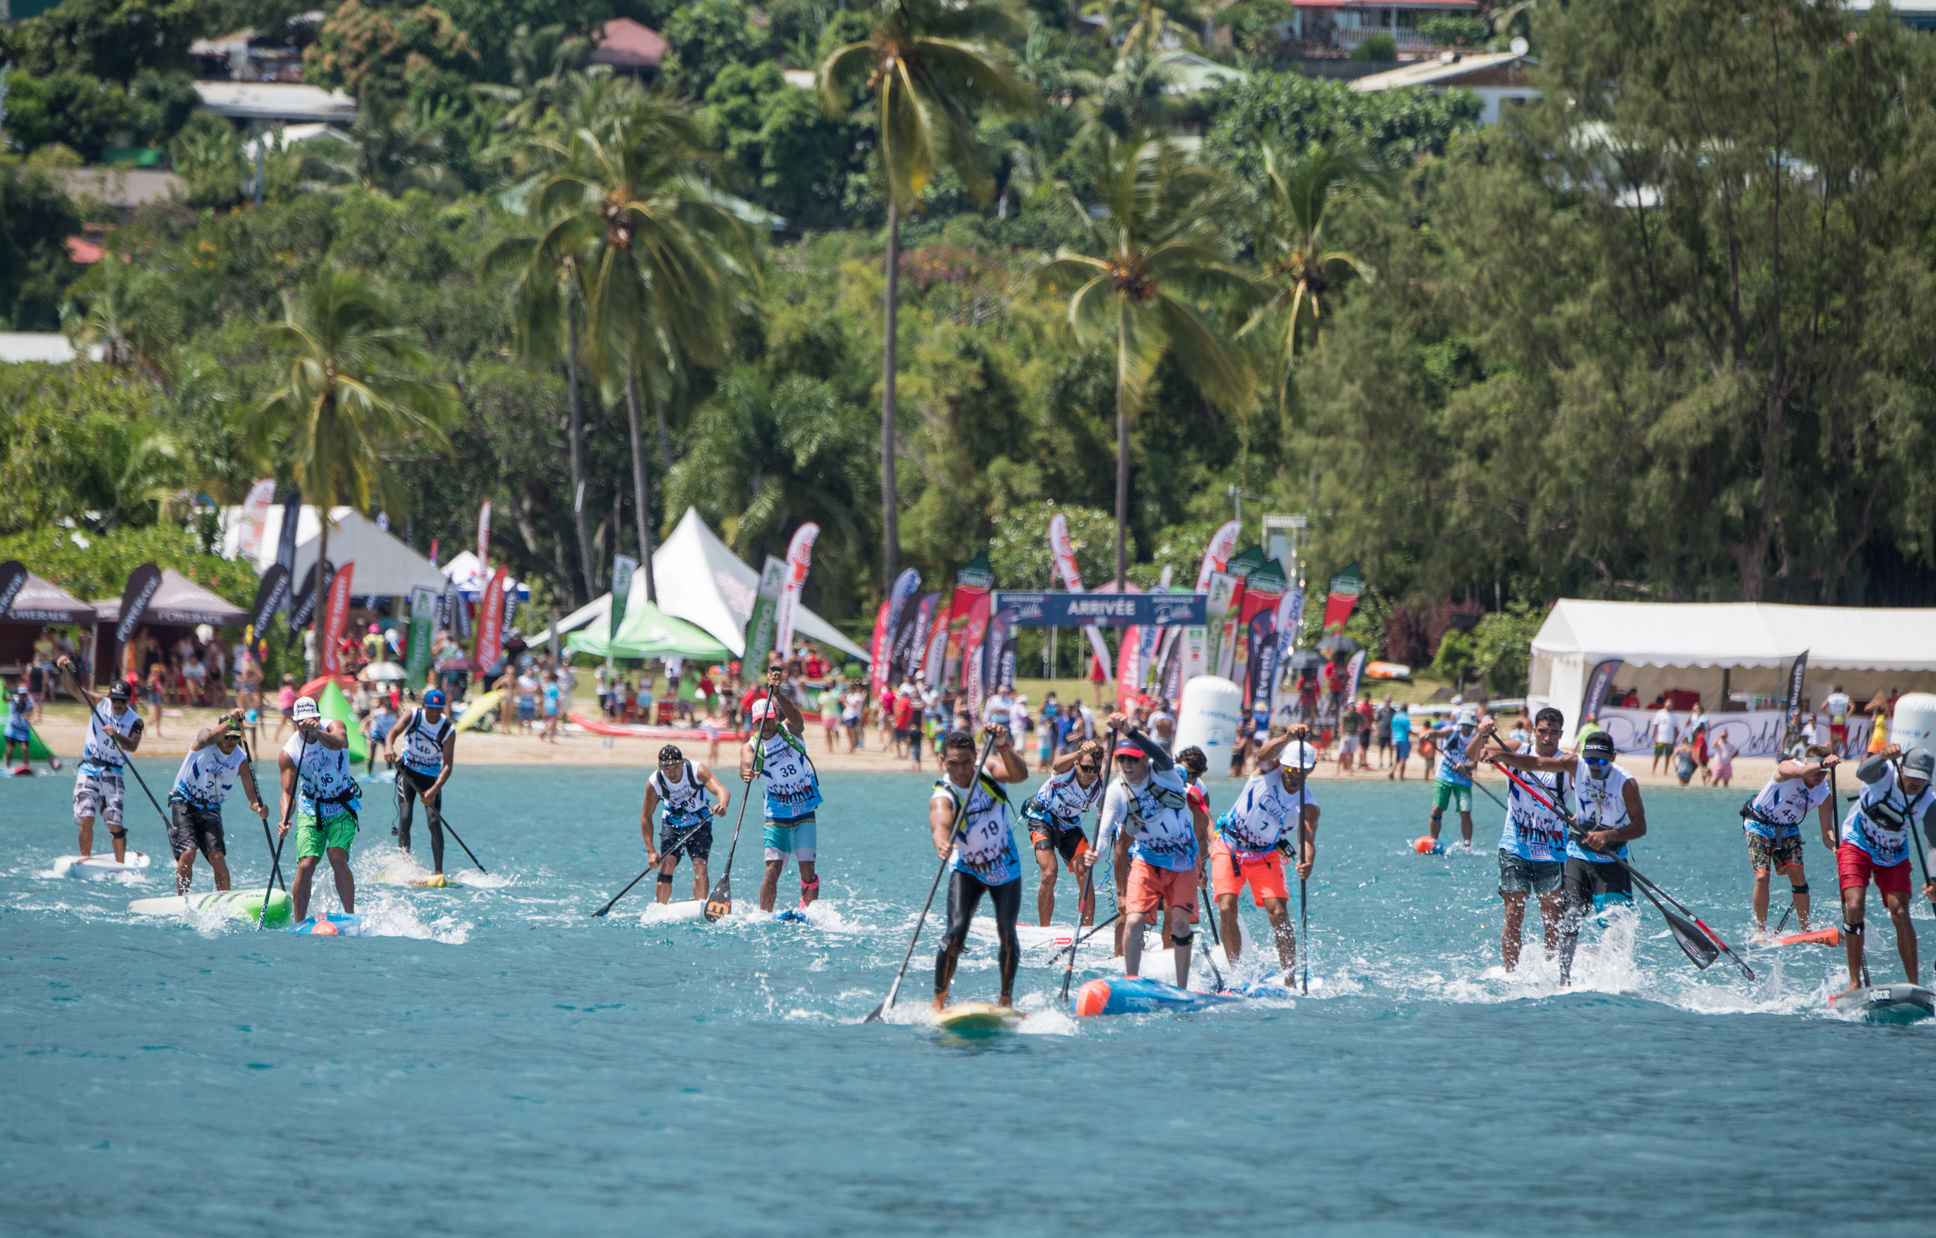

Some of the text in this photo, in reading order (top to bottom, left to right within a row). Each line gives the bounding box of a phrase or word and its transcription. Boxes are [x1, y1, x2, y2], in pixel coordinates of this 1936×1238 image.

[115, 575, 160, 641] POWERADE
[250, 574, 290, 638] POWERADE
[1066, 598, 1136, 616] ARRIVÉE
[780, 763, 797, 778] 38
[320, 774, 334, 788] 96
[1782, 809, 1797, 822] 48
[981, 820, 999, 840] 19
[1160, 821, 1169, 834] 1
[1260, 820, 1270, 831] 7
